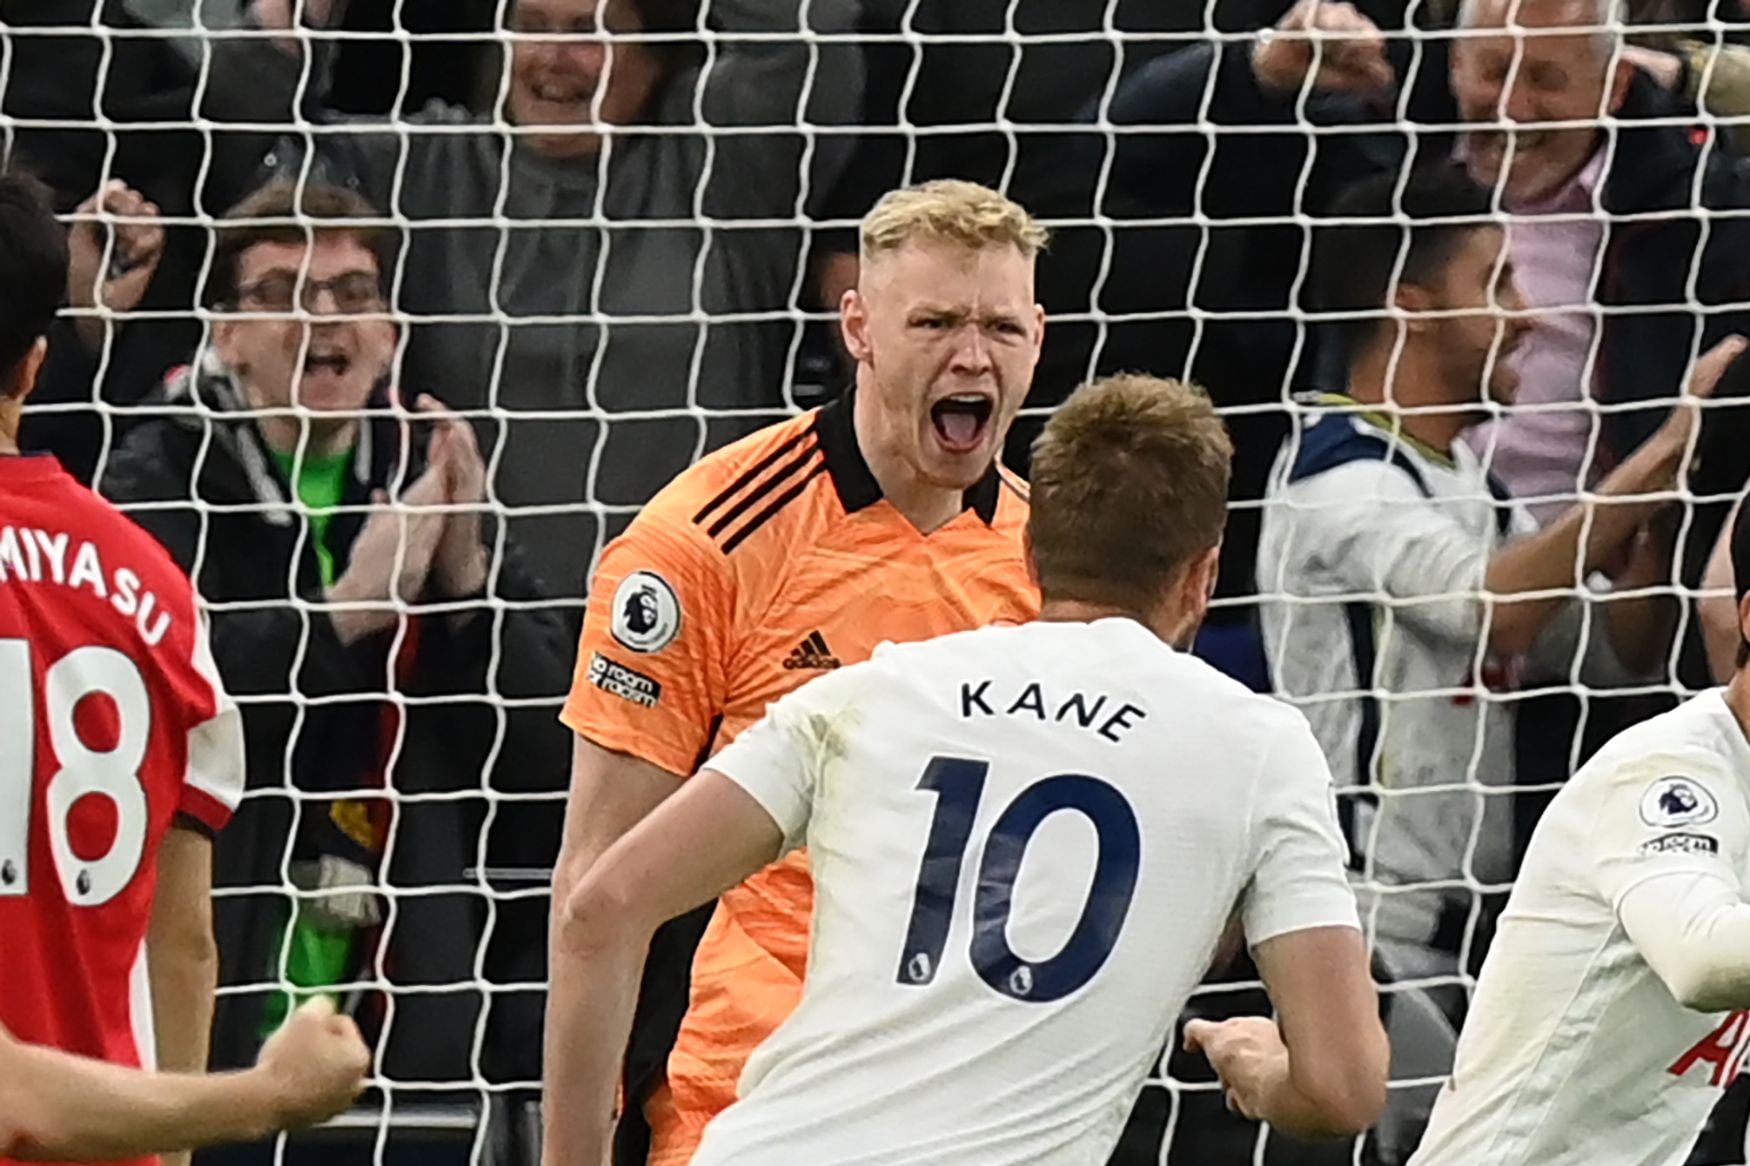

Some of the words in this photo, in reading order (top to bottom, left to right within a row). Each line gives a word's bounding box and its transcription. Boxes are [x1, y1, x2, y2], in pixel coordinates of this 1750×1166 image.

[0, 638, 152, 907] 18
[961, 680, 1148, 743] KANE
[896, 755, 1142, 1003] 10
